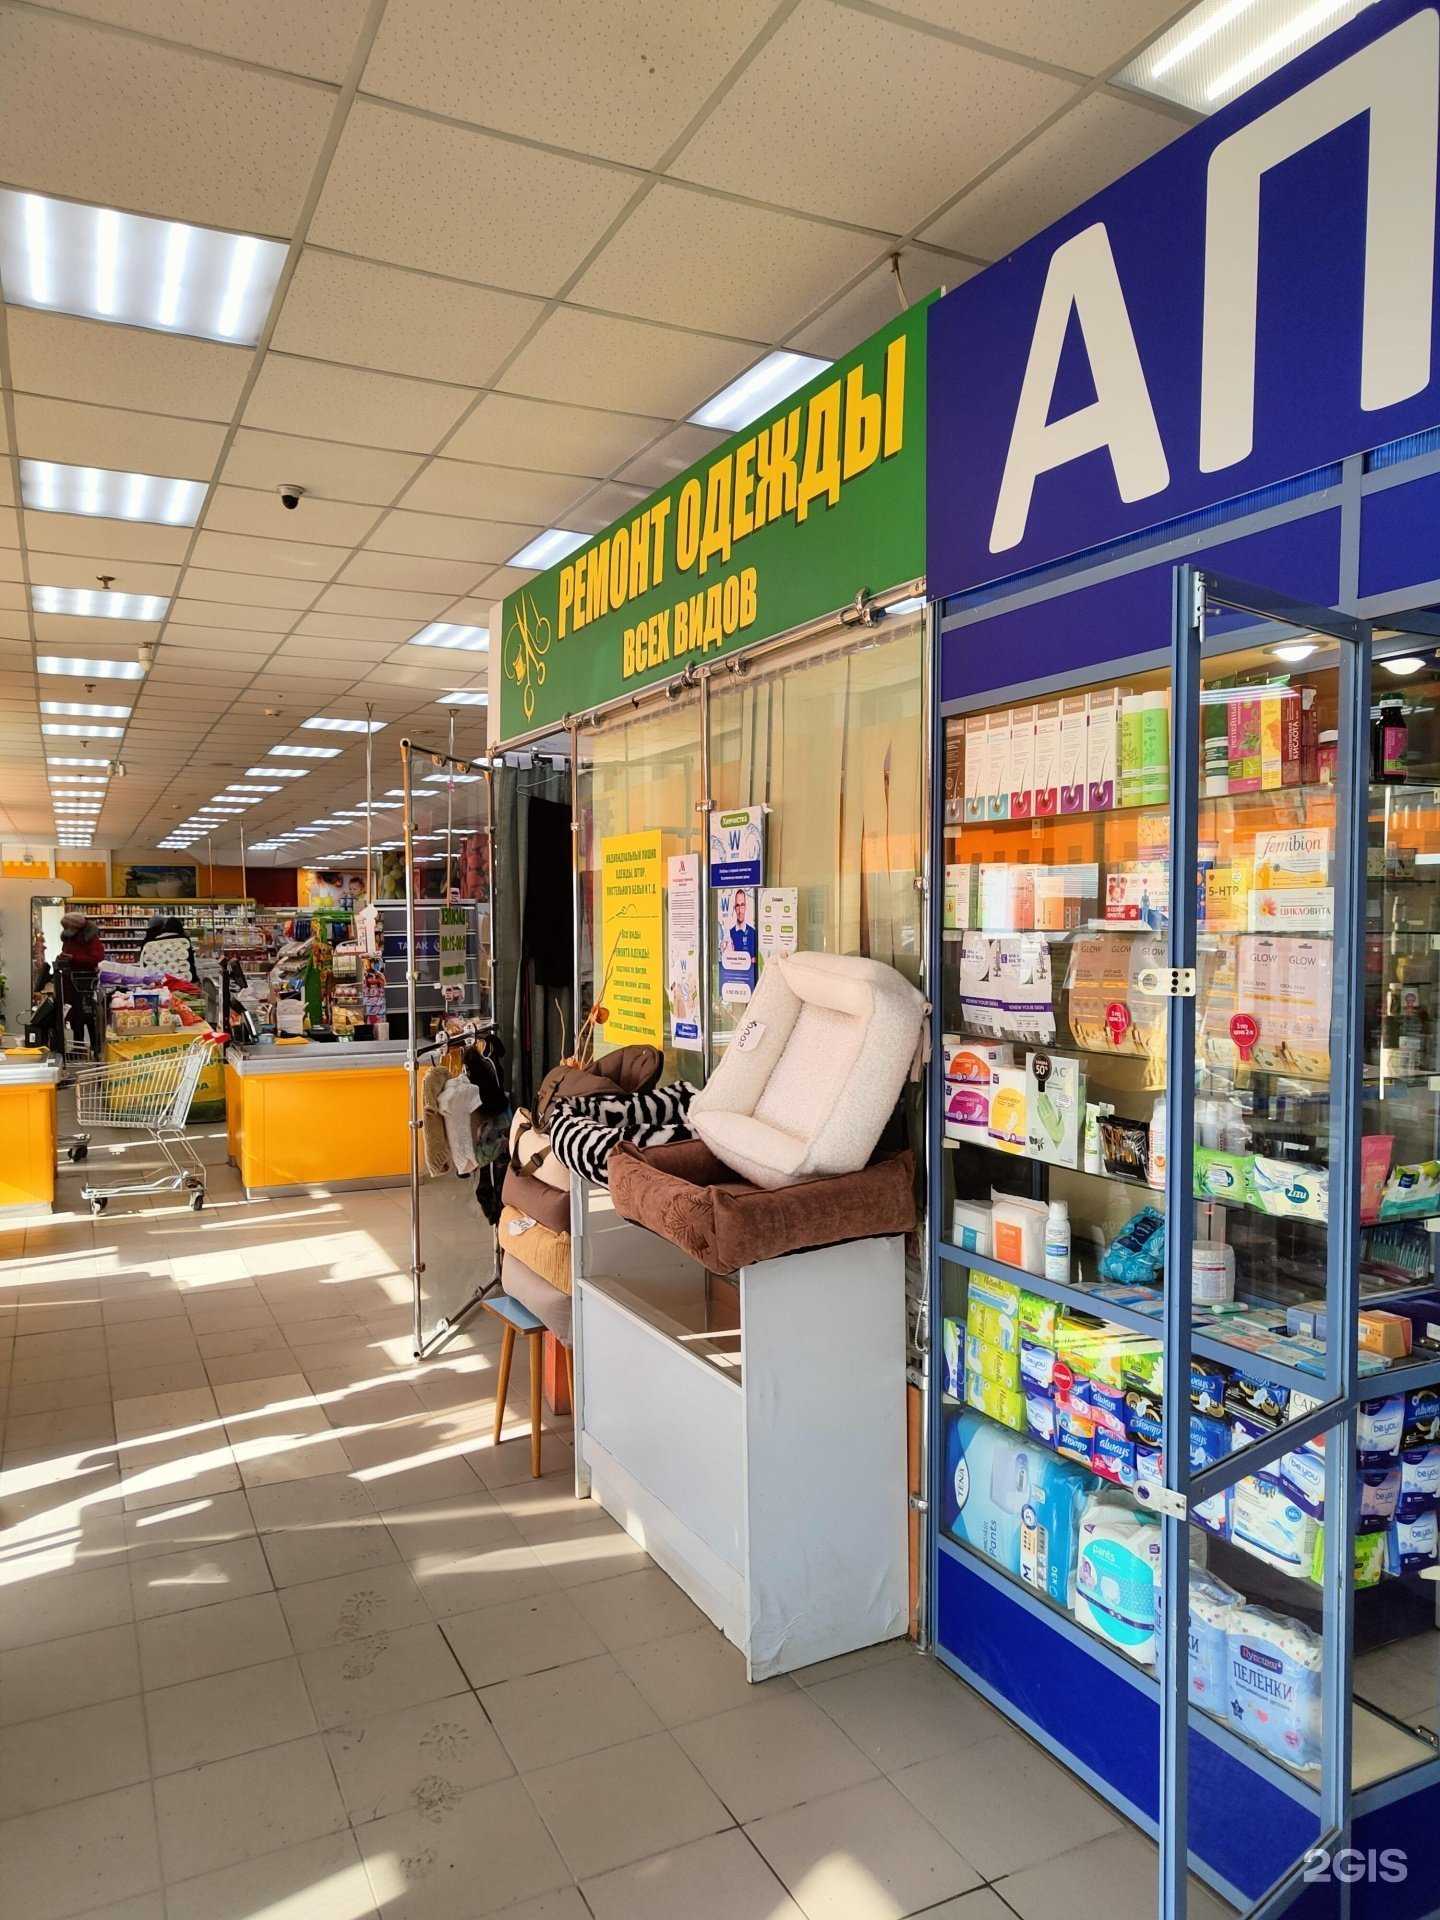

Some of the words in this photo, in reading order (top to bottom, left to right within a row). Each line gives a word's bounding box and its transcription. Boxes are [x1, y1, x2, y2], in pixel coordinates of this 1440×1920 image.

[989, 7, 1439, 554] АП
[558, 496, 671, 640] РЕМОНТ
[676, 334, 907, 574] ОДЕЖДЫ
[622, 603, 671, 679] ВСЕХ
[674, 567, 758, 657] ВИДОВ
[729, 829, 742, 851] W
[1262, 834, 1320, 857] femibion
[721, 897, 730, 913] W
[1280, 905, 1330, 916] ЦИКЛОВИТА
[398, 941, 428, 951] ТААК
[1251, 953, 1277, 962] GLOW
[1289, 955, 1317, 966] GLOW
[133, 1043, 194, 1061] МАРИЯ-Р
[1035, 1065, 1048, 1076] 50%
[1093, 1392, 1116, 1411] always
[1062, 1433, 1088, 1451] always
[1099, 1438, 1130, 1458] always
[988, 1520, 997, 1557] Pants
[1022, 1563, 1032, 1582] M
[1233, 1662, 1292, 1699] ПЕЛЕНКИ
